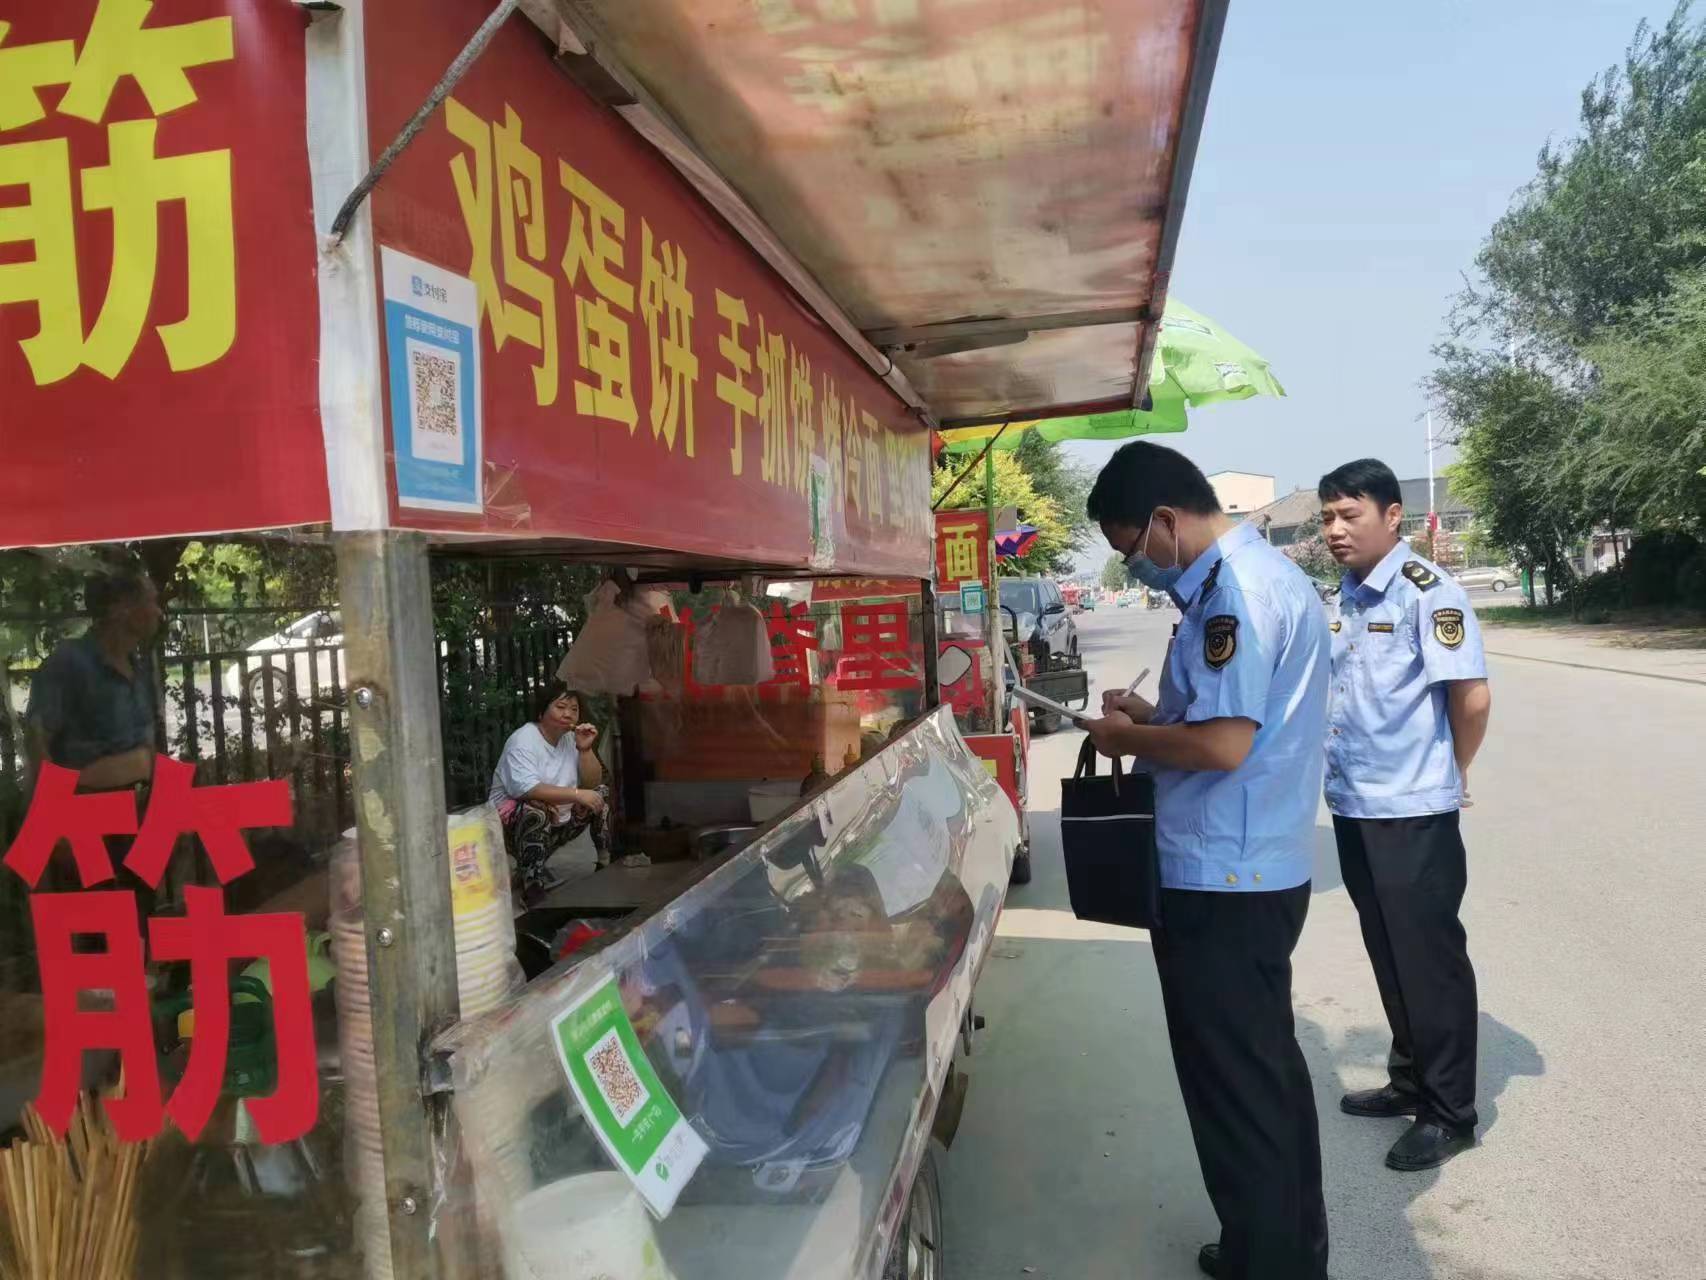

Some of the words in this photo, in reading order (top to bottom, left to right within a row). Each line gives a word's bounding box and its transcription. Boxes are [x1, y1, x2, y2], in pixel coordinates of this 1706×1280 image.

[0, 0, 236, 386] 筋
[444, 96, 700, 458] 鸡蛋饼
[715, 287, 816, 498] 手抓饼
[942, 523, 979, 581] 面
[3, 753, 320, 1145] 筋
